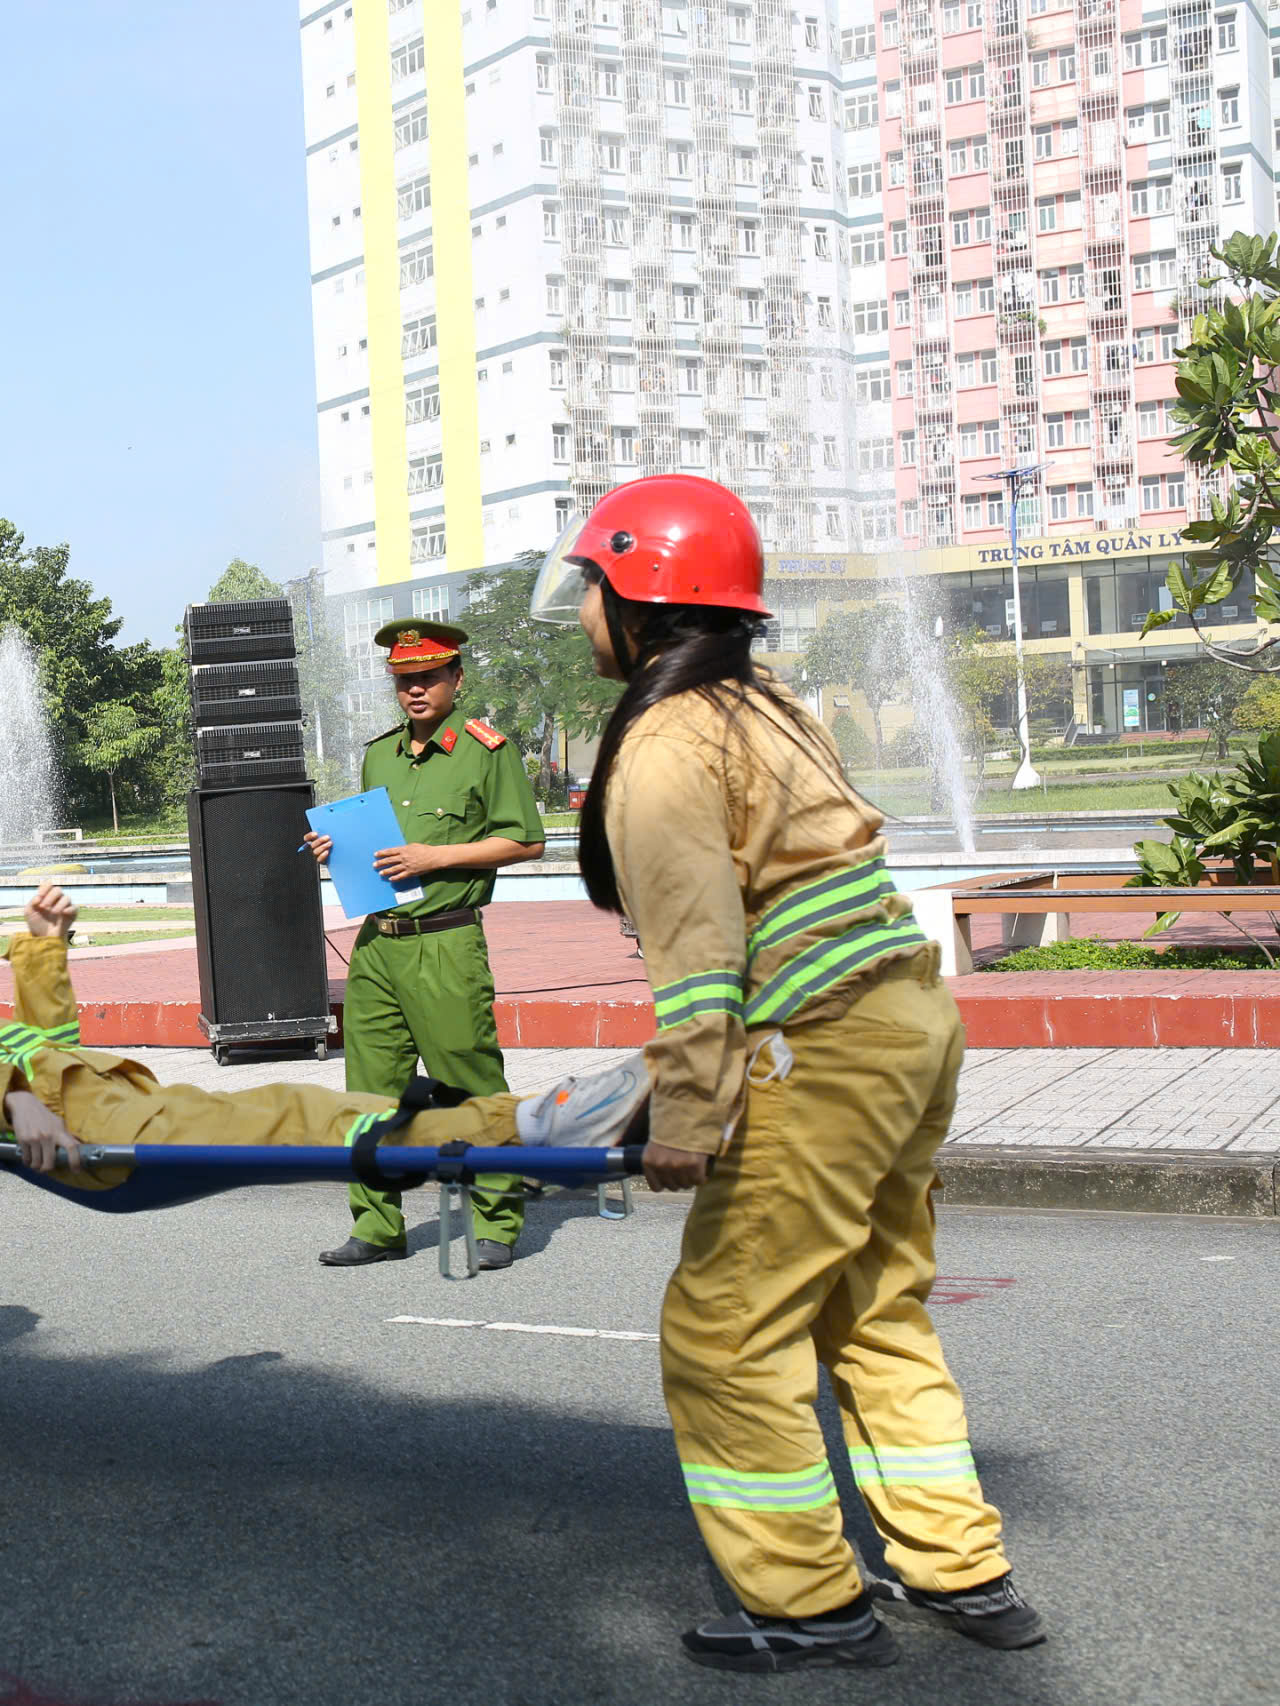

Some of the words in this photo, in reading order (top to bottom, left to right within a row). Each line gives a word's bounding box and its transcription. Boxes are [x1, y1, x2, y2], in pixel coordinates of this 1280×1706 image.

[978, 545, 1044, 563] TRUNG
[1049, 538, 1090, 557] TÂM
[1096, 531, 1152, 554] QUẢN
